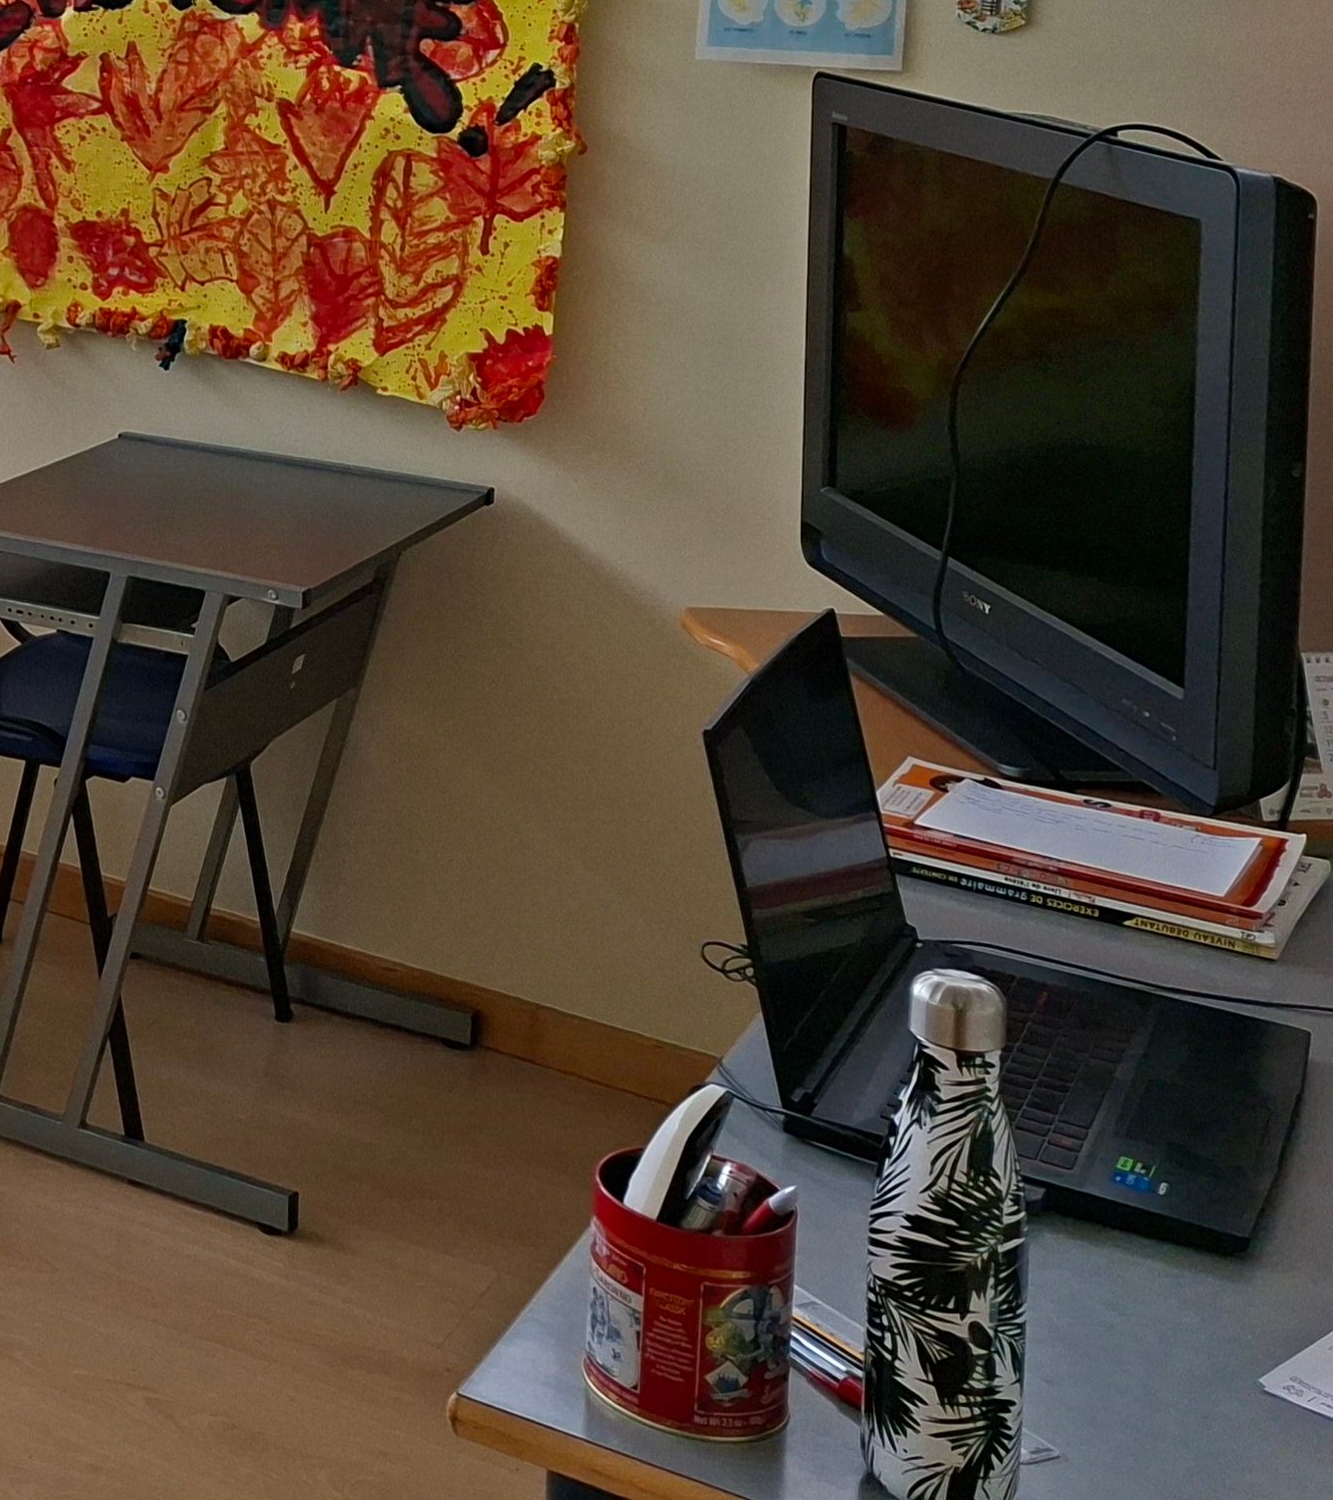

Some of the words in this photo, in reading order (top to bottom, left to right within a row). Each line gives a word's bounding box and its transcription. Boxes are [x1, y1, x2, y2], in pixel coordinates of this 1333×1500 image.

[963, 591, 991, 615] SONY
[959, 877, 1027, 901] grammaire
[1029, 894, 1043, 906] DE
[1046, 896, 1100, 918] EXERCICES
[1192, 930, 1236, 950] NIVEAU
